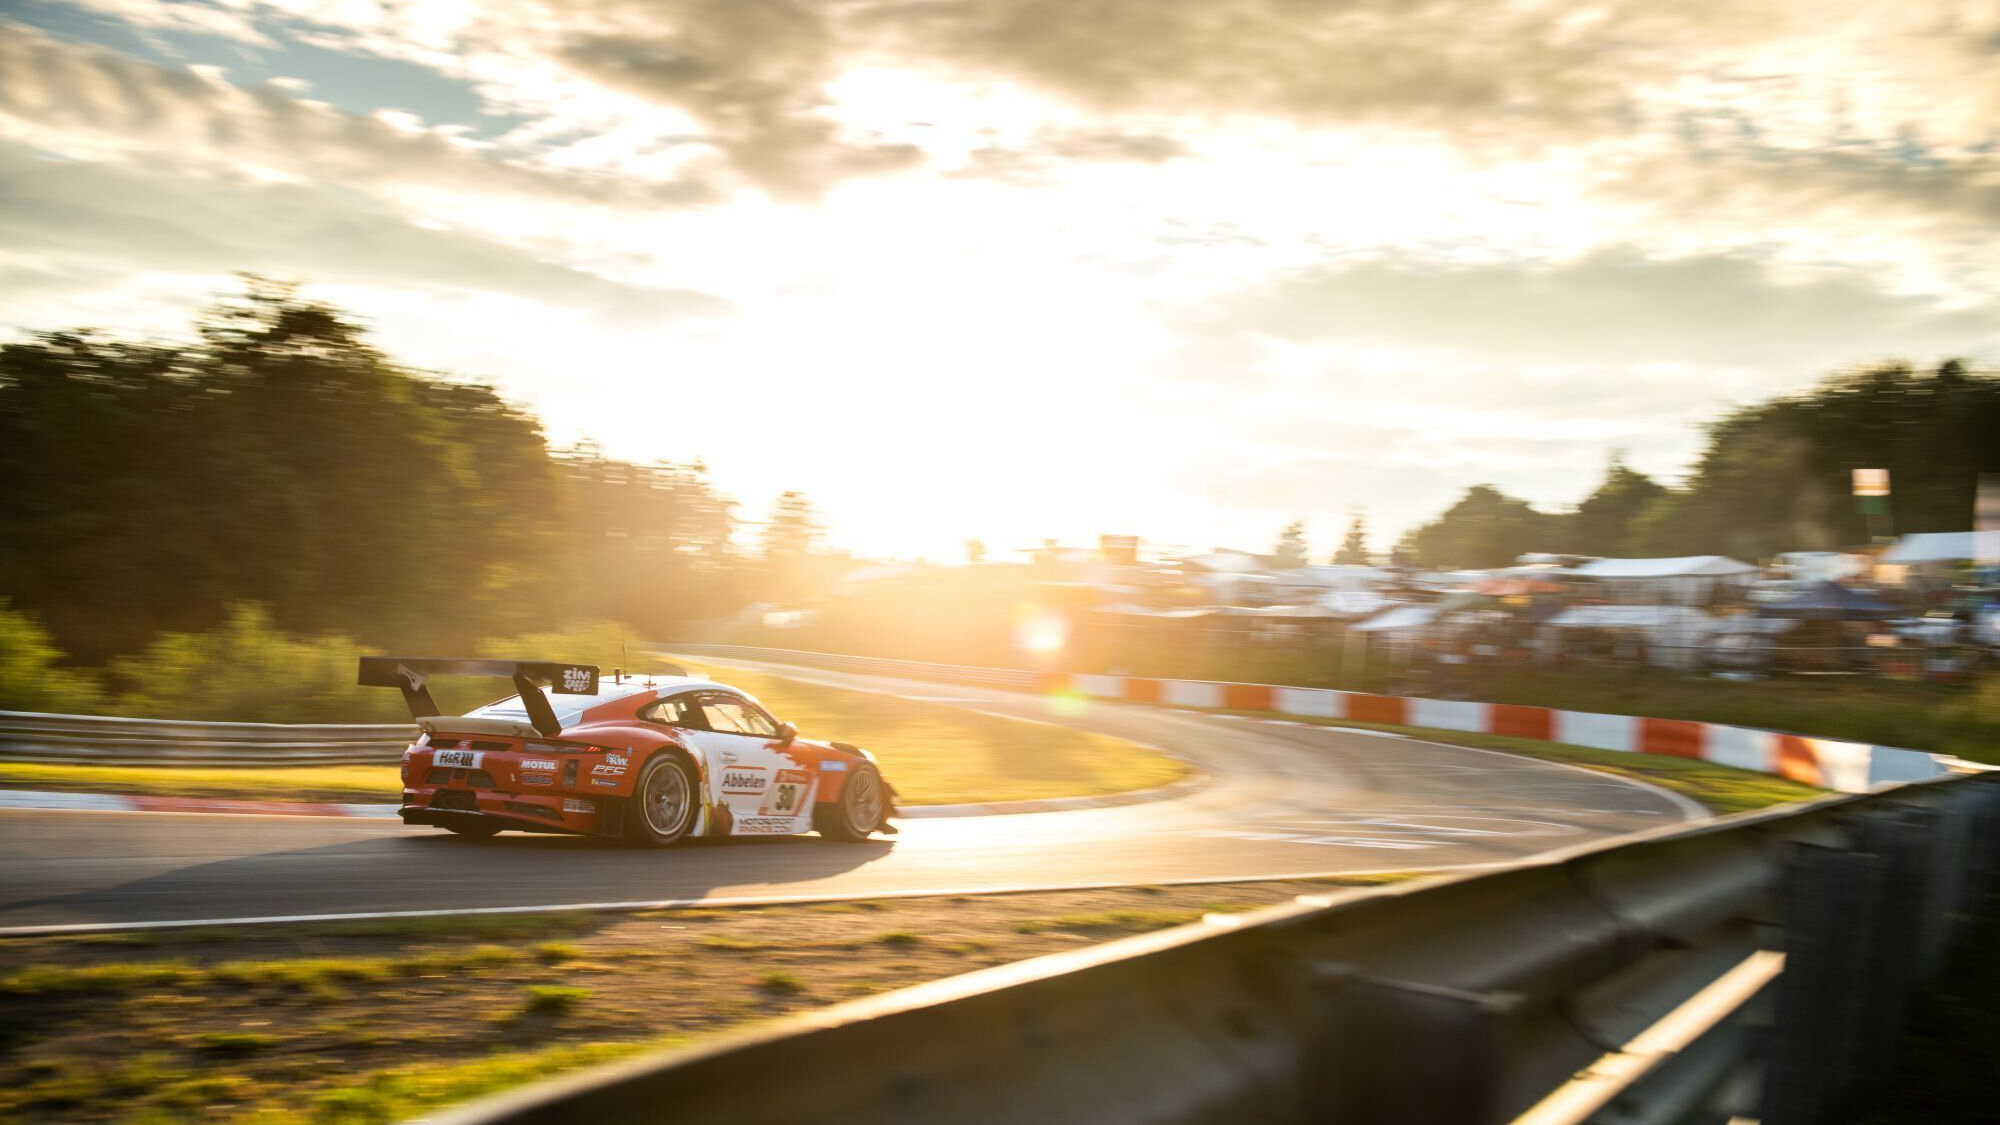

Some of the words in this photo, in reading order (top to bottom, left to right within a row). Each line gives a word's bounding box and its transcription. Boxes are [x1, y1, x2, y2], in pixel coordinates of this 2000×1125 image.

[521, 760, 556, 770] MOTUL
[592, 764, 627, 774] PFC
[722, 773, 766, 788] Abbelen
[775, 784, 796, 811] 30
